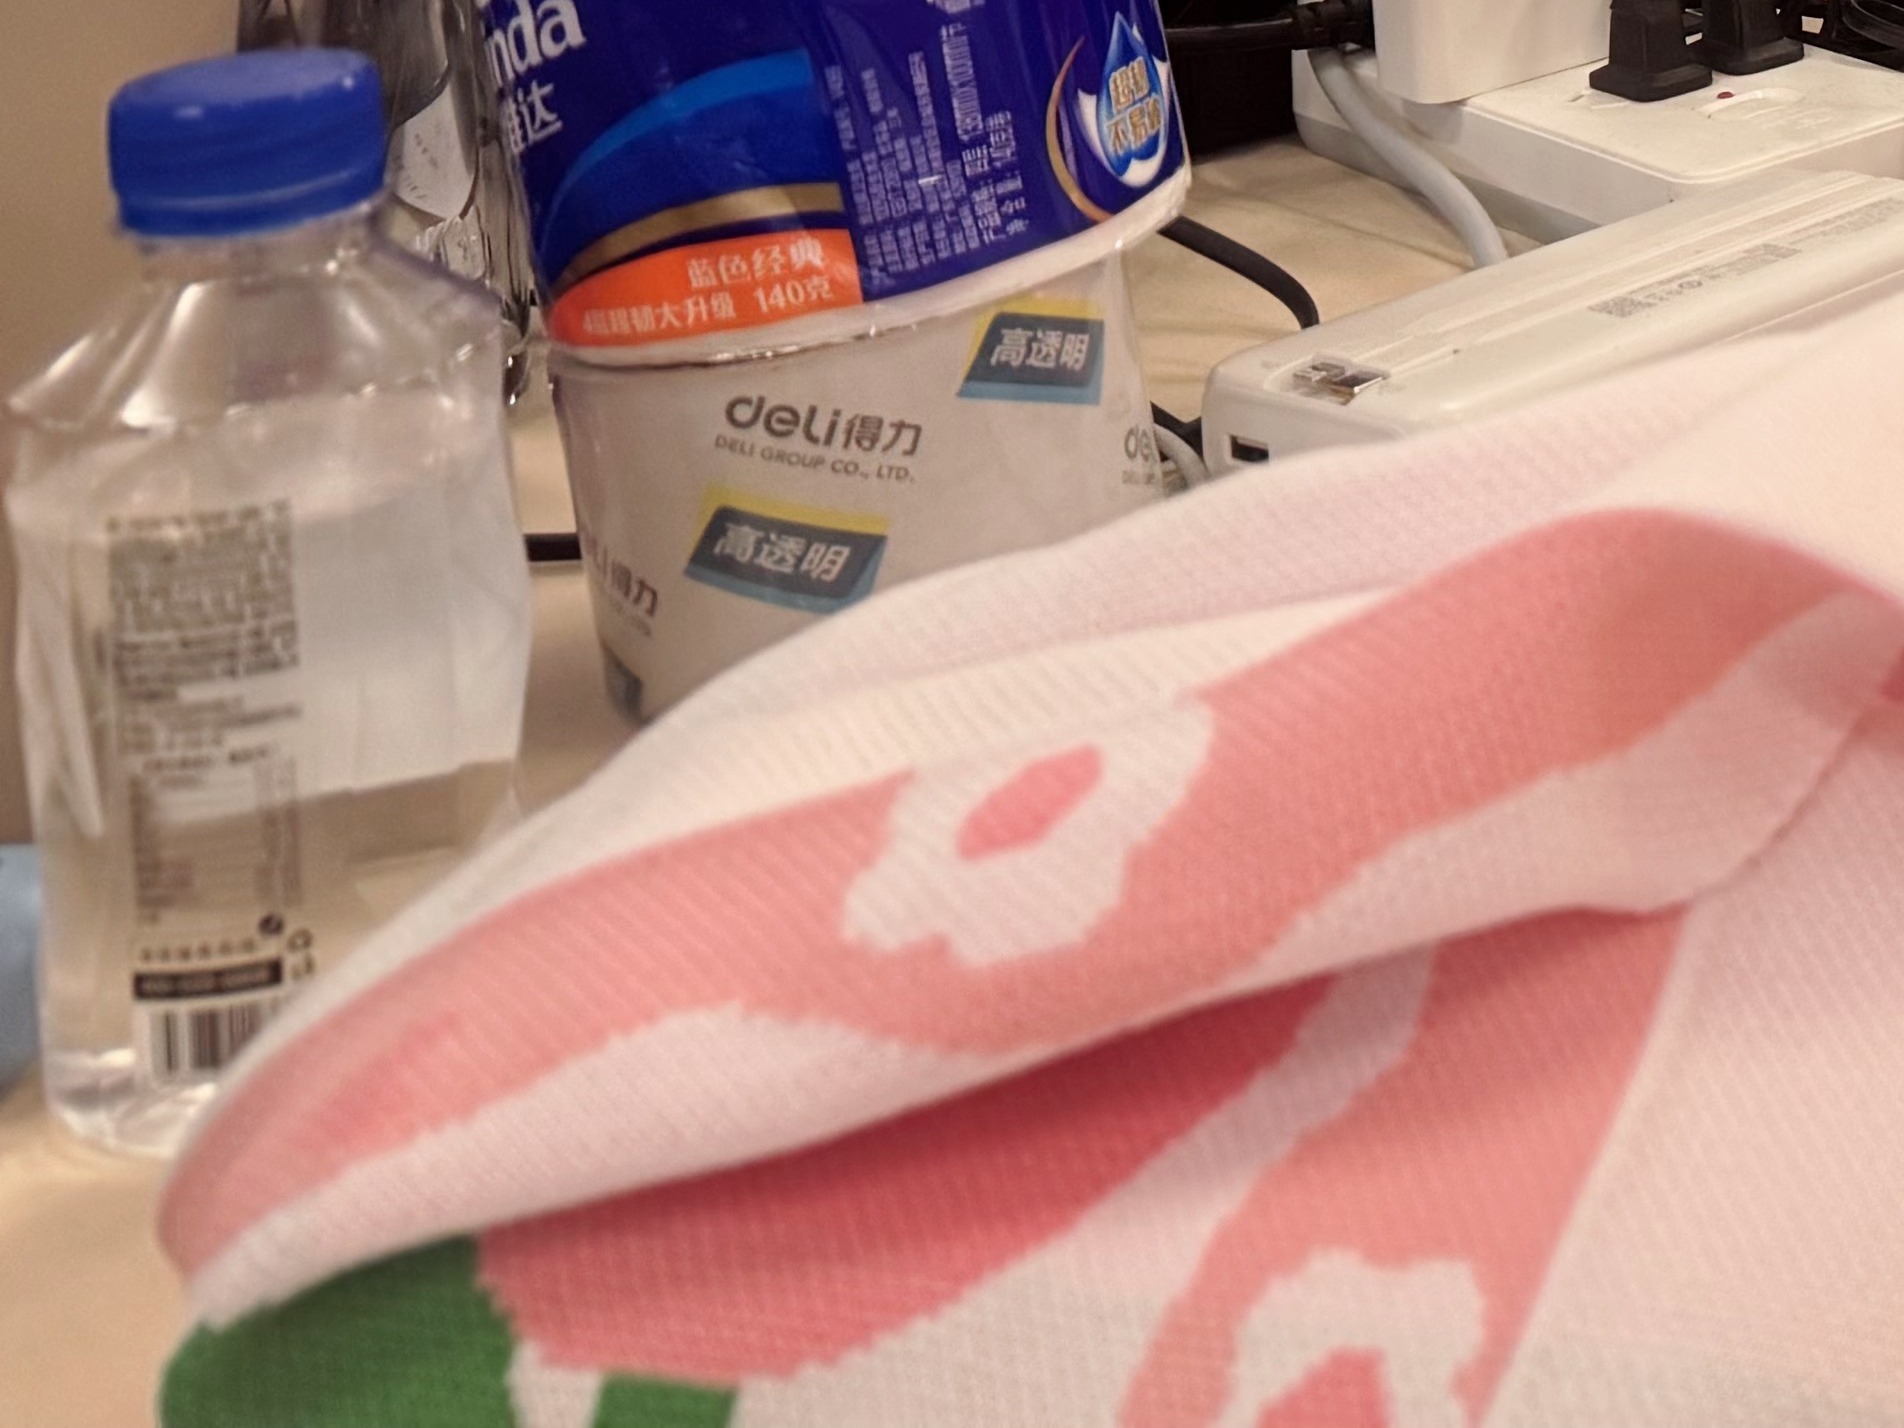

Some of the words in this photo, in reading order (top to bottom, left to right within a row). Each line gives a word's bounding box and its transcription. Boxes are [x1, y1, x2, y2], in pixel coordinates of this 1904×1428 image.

[687, 237, 826, 289] 蓝色经典
[752, 275, 834, 314] 140克
[989, 326, 1091, 373] 高透明
[725, 394, 838, 445] deli
[843, 412, 923, 458] 得力
[714, 434, 756, 464] DELI
[760, 443, 826, 474] GROUP
[830, 454, 871, 480] CO.,
[875, 461, 917, 484] LTD.
[713, 523, 851, 584] 高透明
